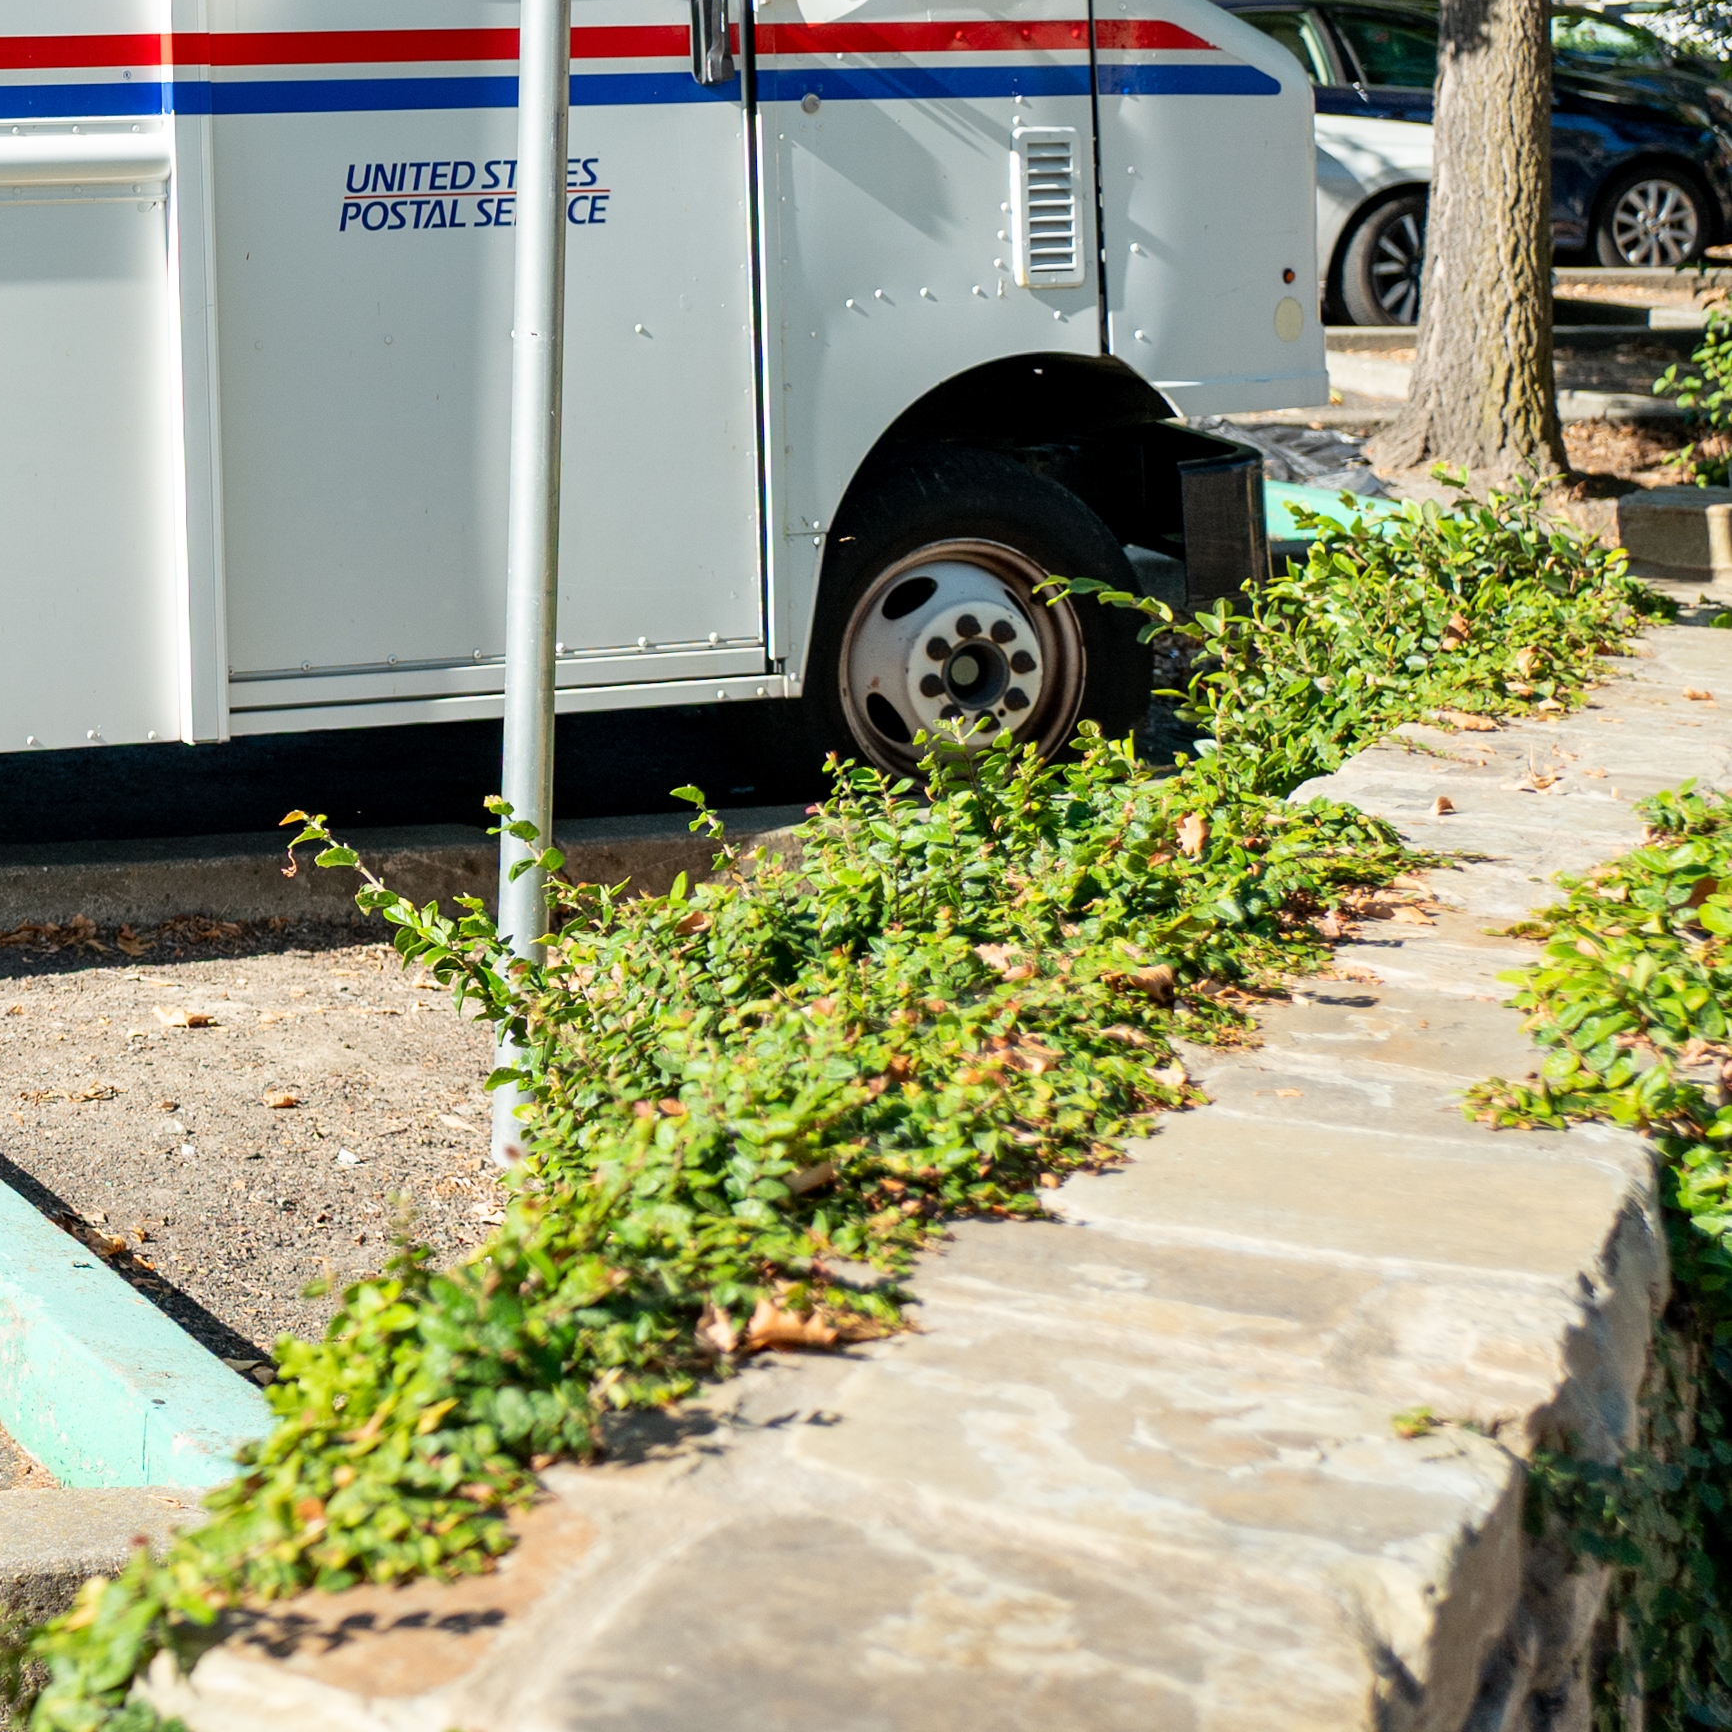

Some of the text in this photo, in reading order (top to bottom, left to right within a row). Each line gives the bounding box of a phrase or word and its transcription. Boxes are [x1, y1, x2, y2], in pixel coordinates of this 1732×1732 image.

[347, 158, 599, 193] UNITED STES
[340, 195, 610, 231] POSTAL SECE
